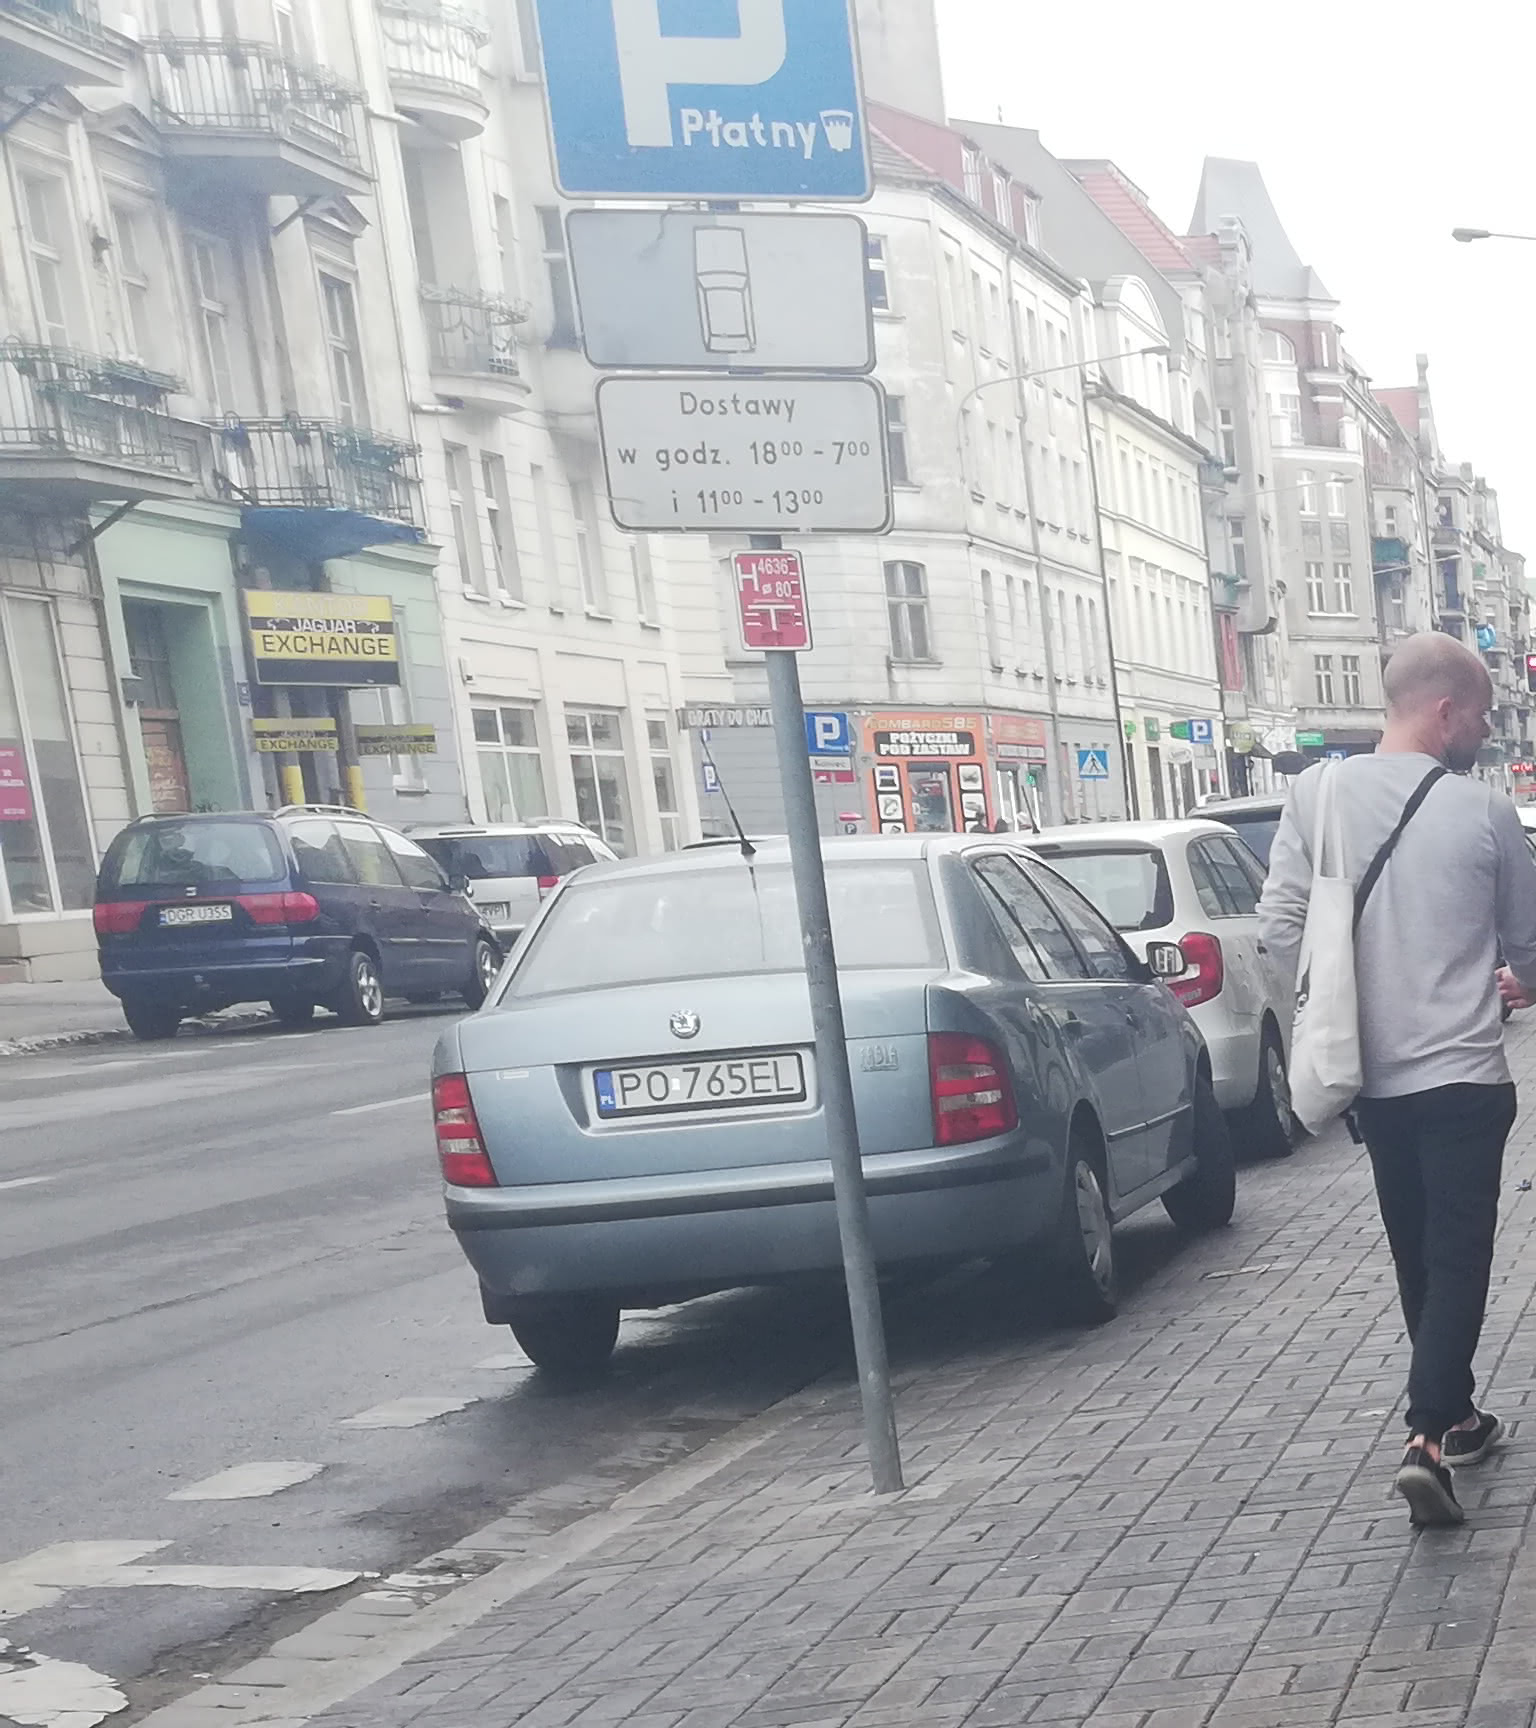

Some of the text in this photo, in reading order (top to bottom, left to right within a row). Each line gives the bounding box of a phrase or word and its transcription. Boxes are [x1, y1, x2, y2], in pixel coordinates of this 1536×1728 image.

[680, 107, 818, 159] Płatny
[679, 391, 796, 423] Dostawy
[616, 447, 638, 466] w
[655, 444, 731, 472] godz.
[672, 491, 680, 513] i
[758, 558, 789, 576] 4636
[775, 580, 792, 597] 80
[292, 618, 357, 633] JAGUAR
[262, 634, 392, 656] EXCHANGE
[745, 708, 774, 726] CHAT
[814, 715, 841, 749] P
[260, 738, 336, 750] EXCHANGE
[880, 743, 970, 756] POD ZASTAW
[619, 1070, 671, 1106] PO
[681, 1061, 795, 1100] 765EL
